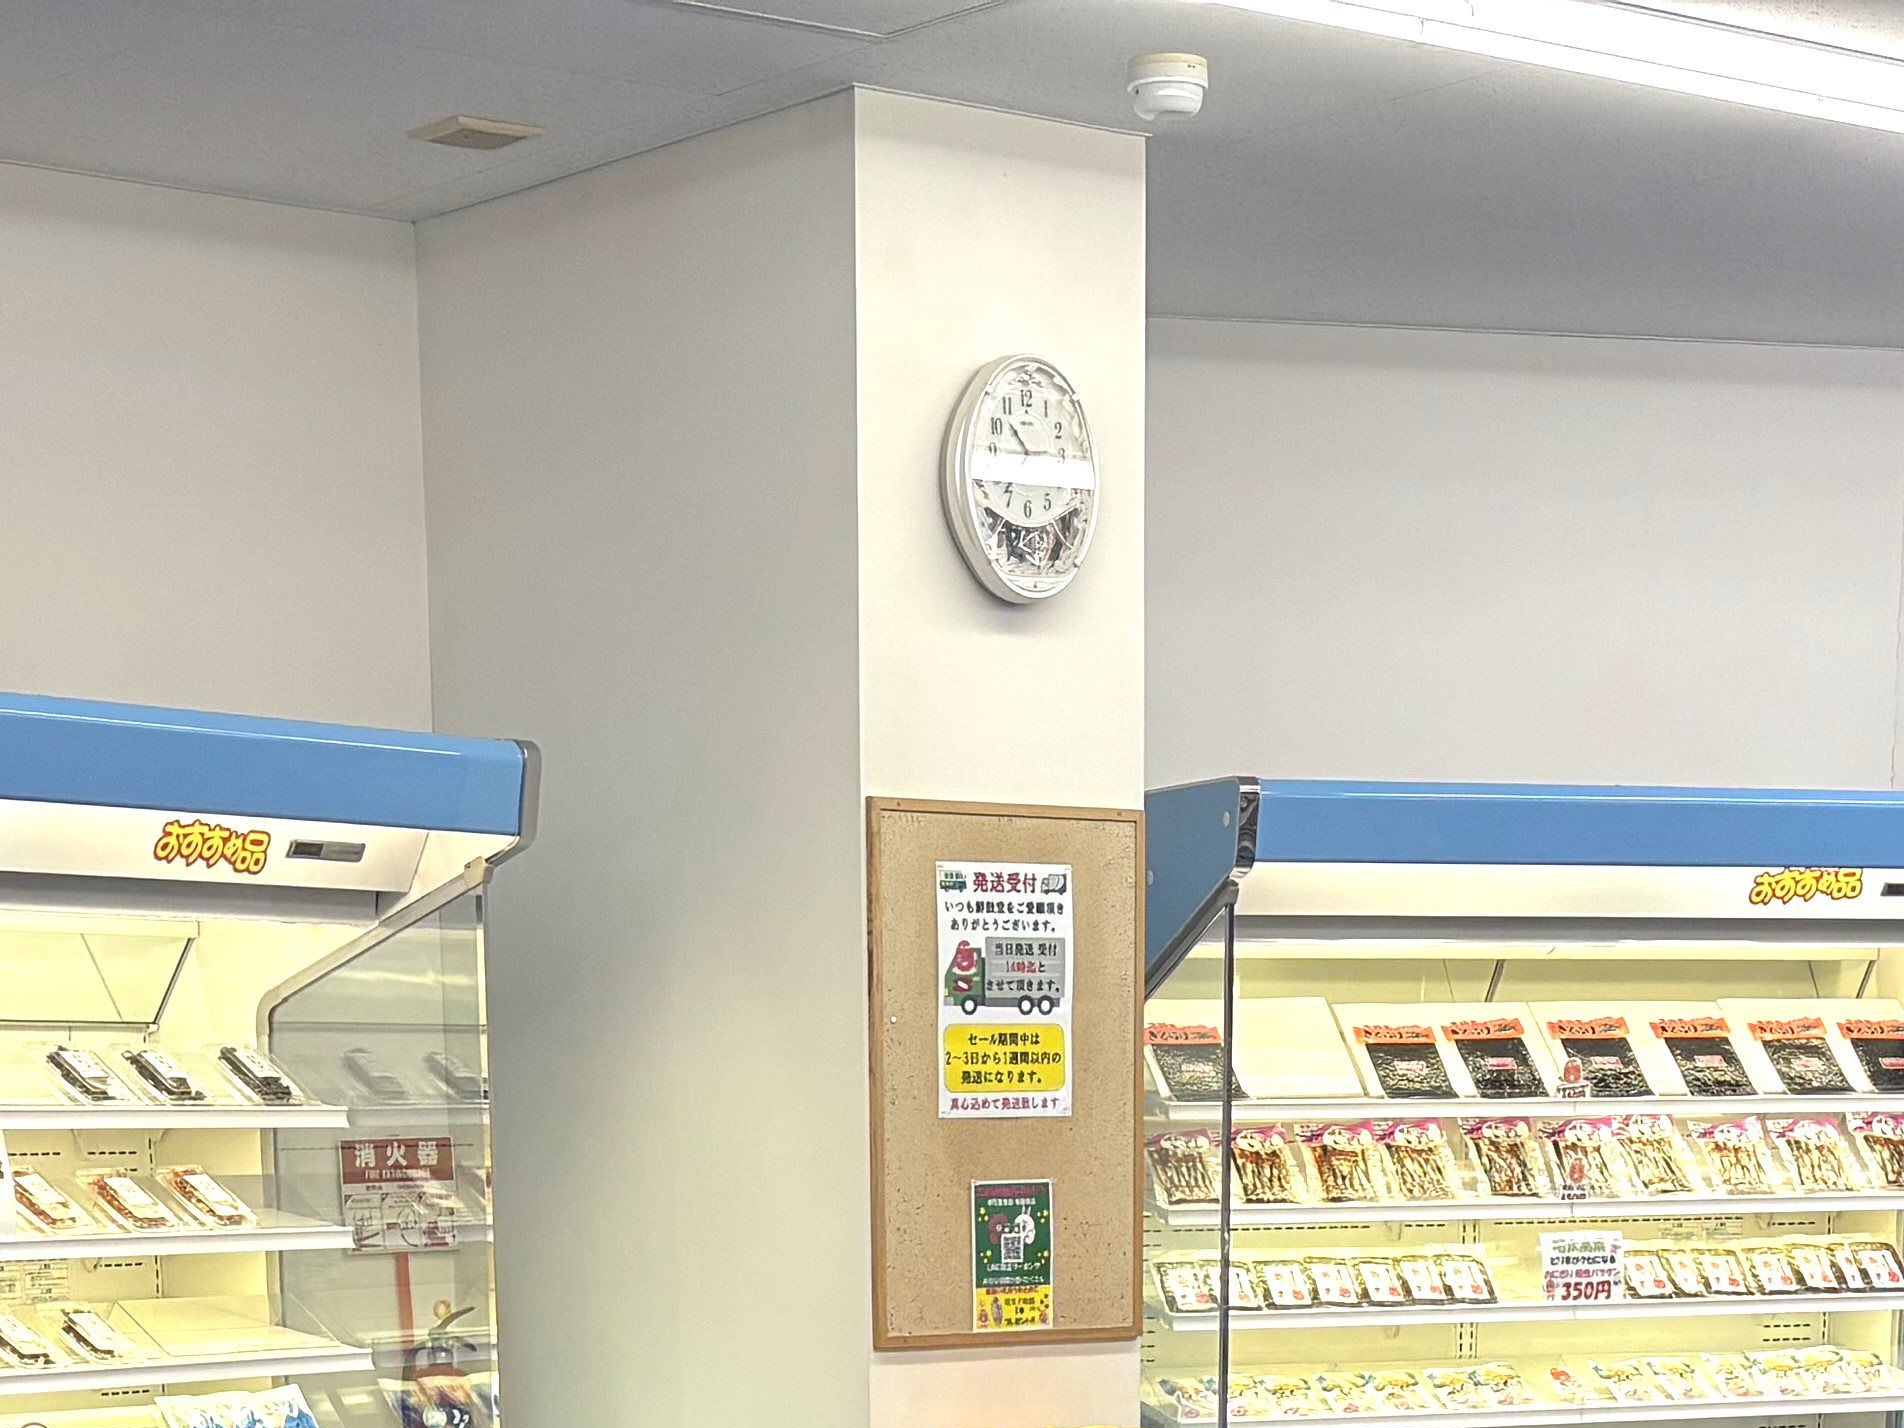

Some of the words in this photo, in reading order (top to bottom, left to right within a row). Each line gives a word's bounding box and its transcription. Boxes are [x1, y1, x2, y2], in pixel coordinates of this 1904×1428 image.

[154, 819, 271, 874] おすすめ品
[973, 872, 1037, 893] 発送受付
[1749, 867, 1863, 905] おすすめ品
[950, 918, 1055, 932] ありがとうございます。
[355, 1141, 438, 1168] 消火器
[1561, 1279, 1612, 1301] 350円
